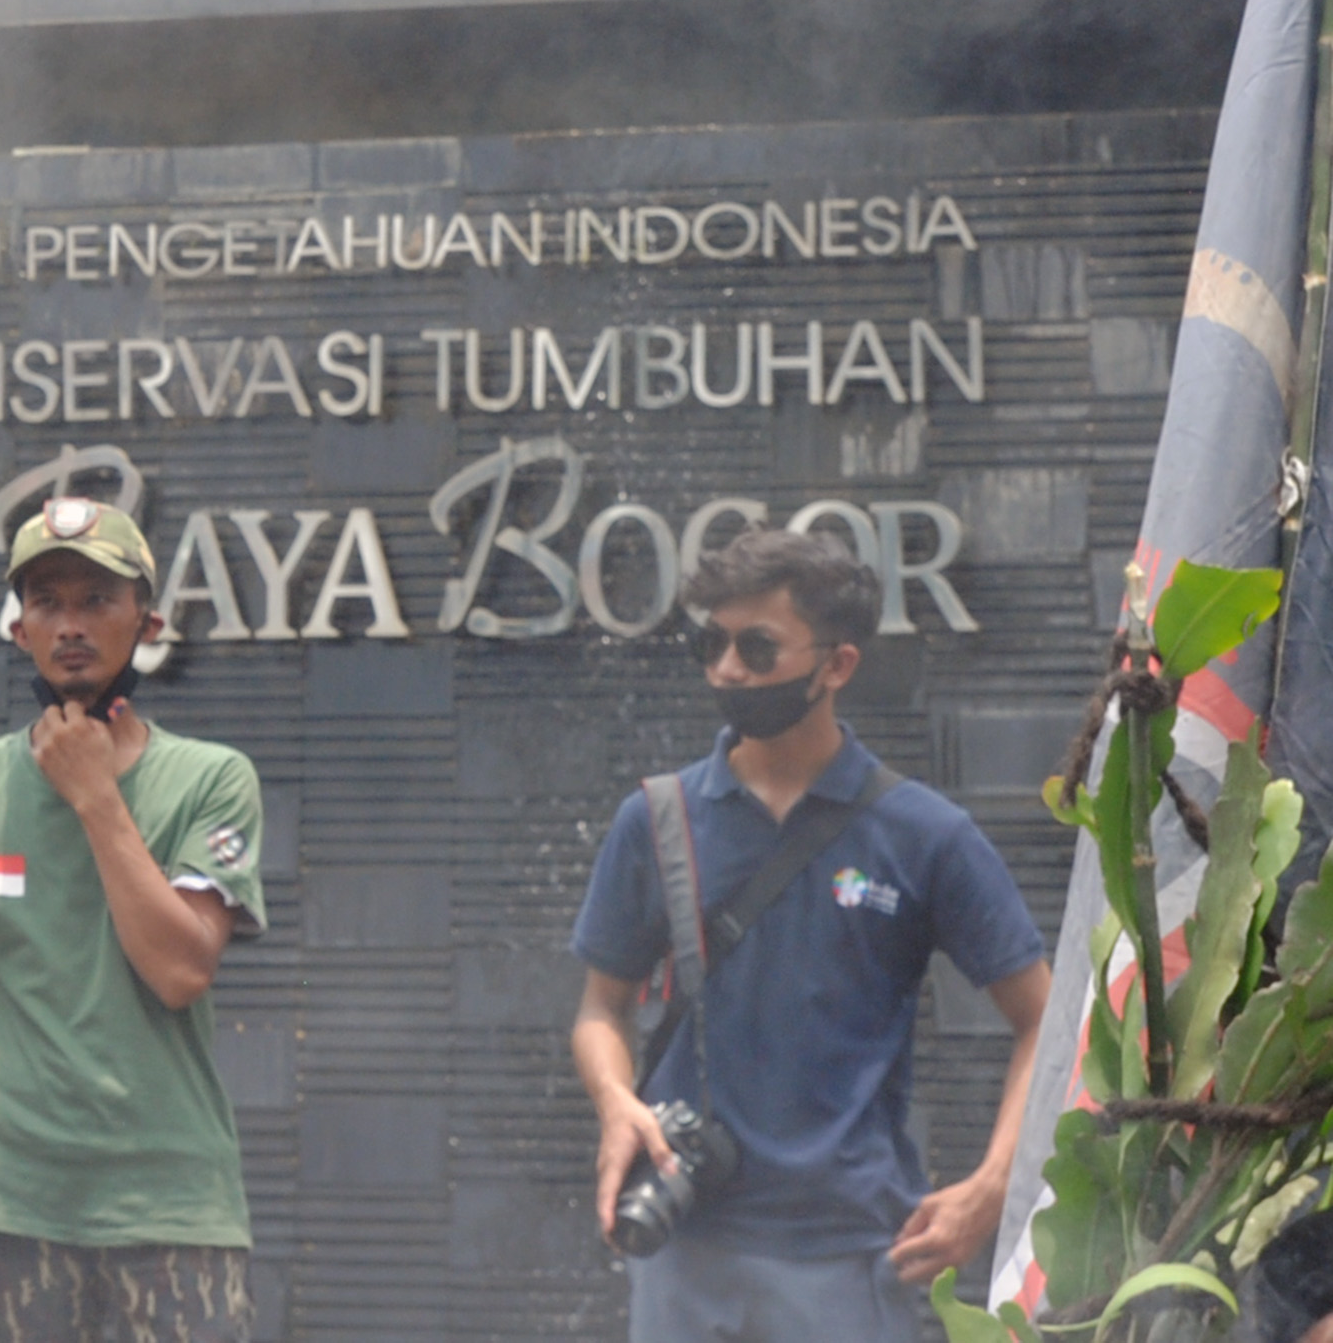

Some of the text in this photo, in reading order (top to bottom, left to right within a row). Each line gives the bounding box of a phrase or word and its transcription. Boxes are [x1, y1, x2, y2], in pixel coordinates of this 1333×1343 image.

[25, 212, 542, 283] PENGETAHUAN
[564, 195, 978, 266] INDONESIA
[421, 316, 986, 414] TUMBUHAN
